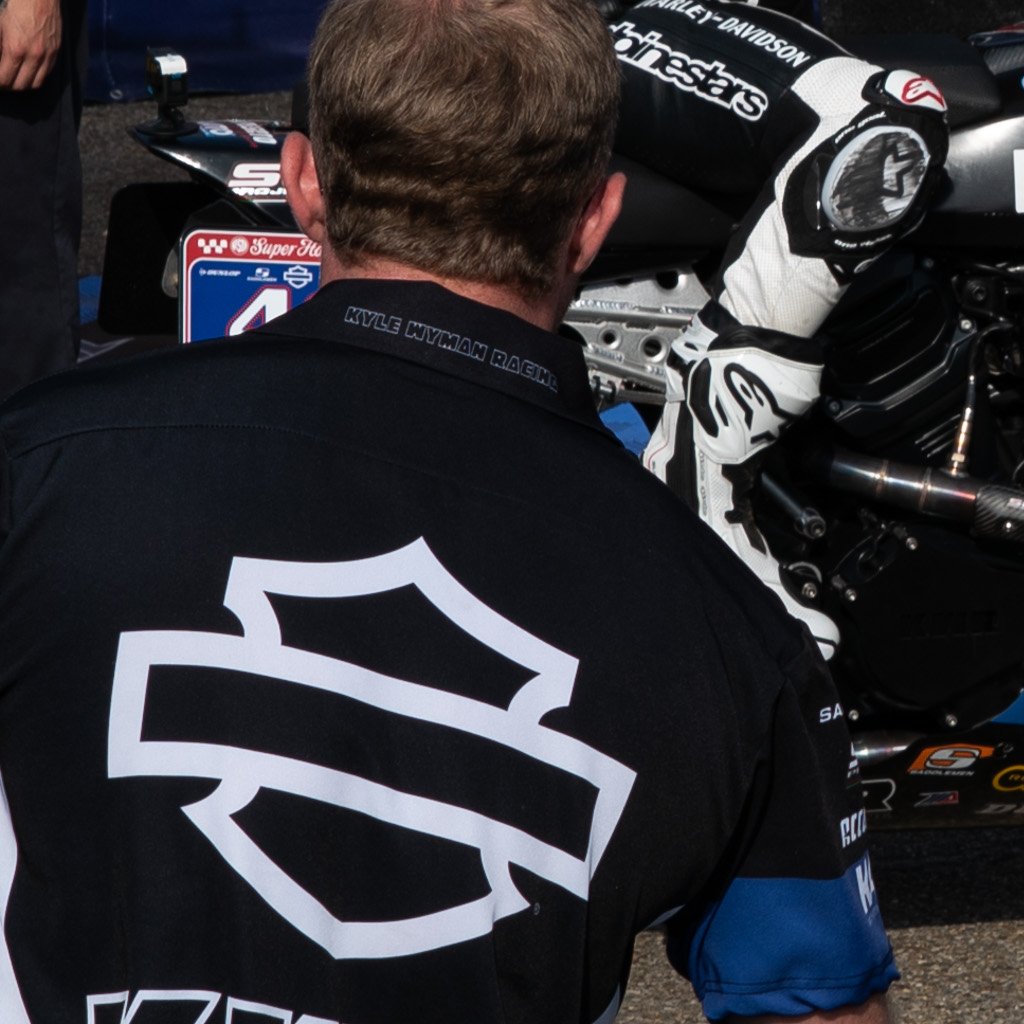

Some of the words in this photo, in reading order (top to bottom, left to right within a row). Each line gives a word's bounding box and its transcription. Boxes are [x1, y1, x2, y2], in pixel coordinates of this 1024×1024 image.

[250, 237, 297, 259] Super
[344, 305, 402, 335] KYLE
[404, 320, 489, 362] WYMAN
